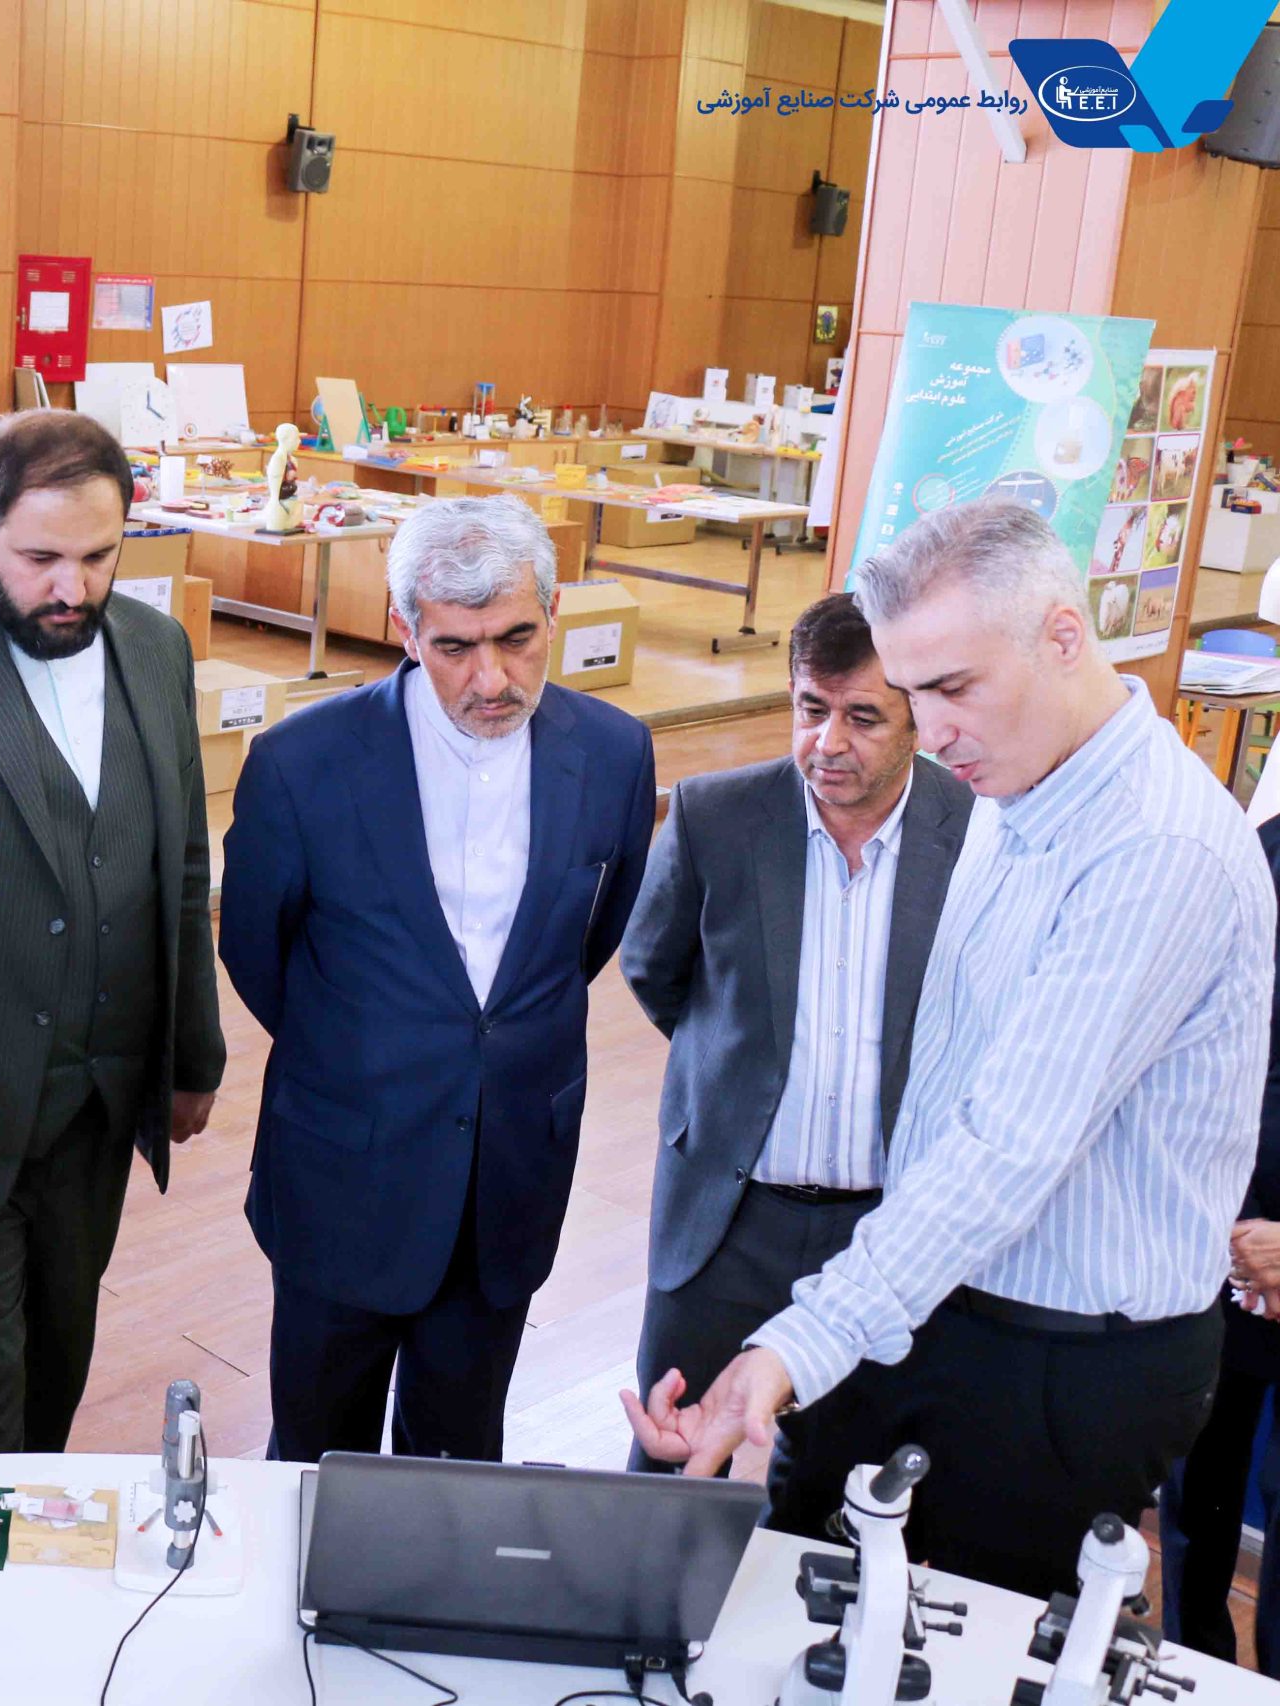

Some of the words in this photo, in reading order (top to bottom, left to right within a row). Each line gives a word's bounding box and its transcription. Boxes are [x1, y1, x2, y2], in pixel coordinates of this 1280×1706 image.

[949, 362, 991, 377] مجموعه
[929, 373, 969, 389] آموزش
[940, 394, 967, 407] علوم
